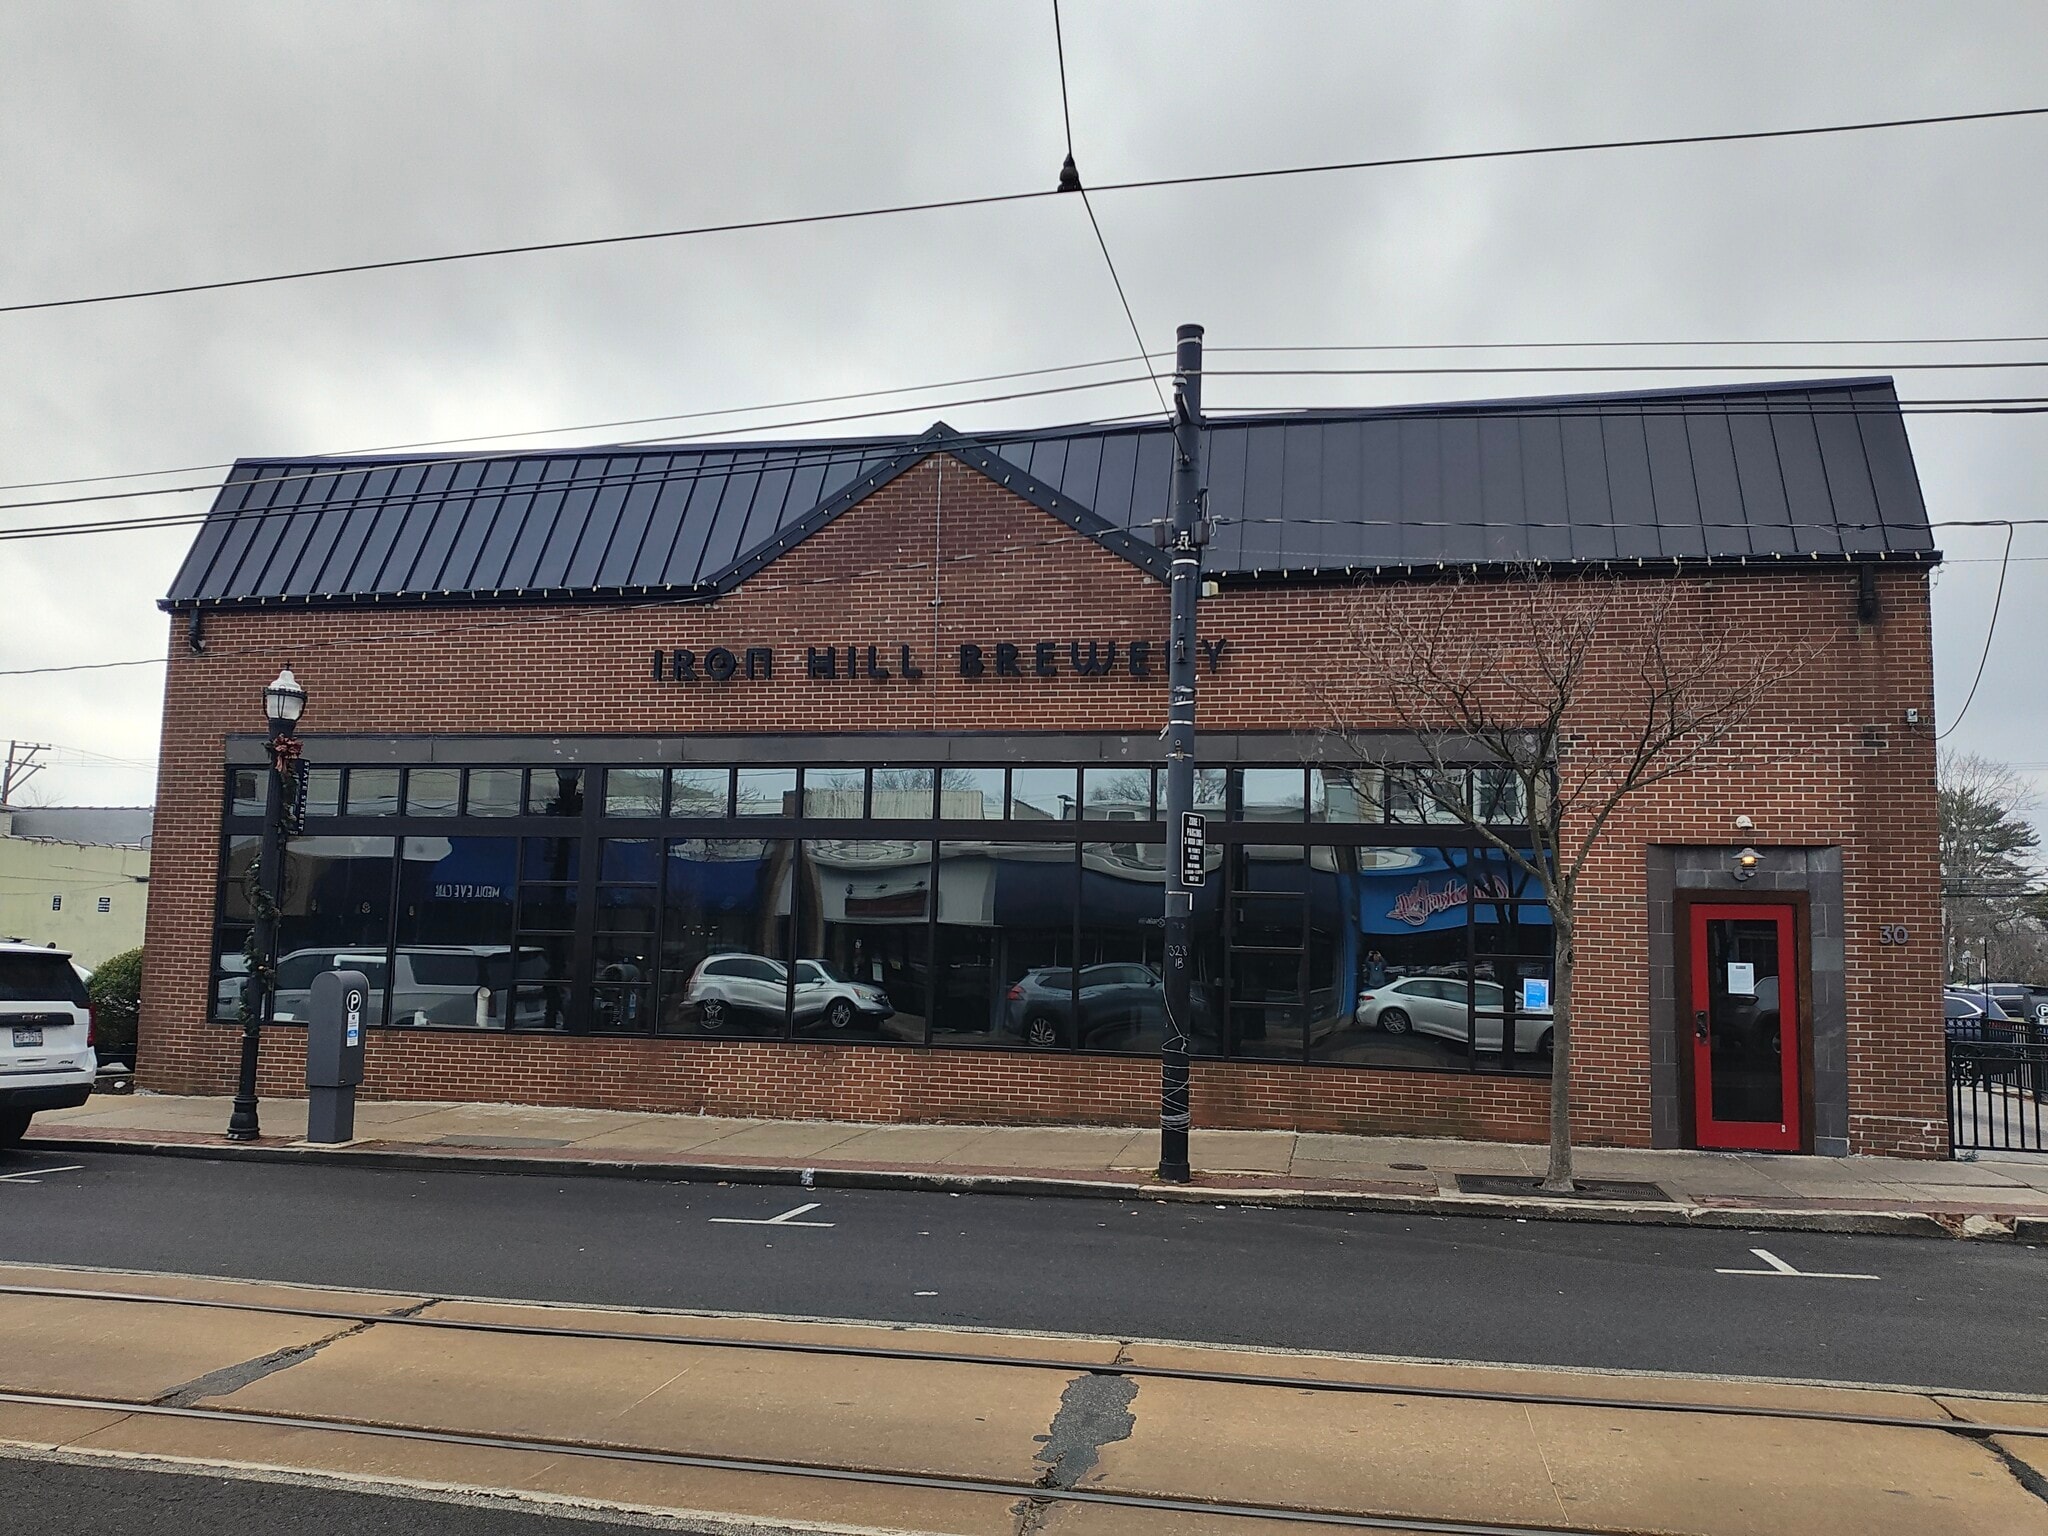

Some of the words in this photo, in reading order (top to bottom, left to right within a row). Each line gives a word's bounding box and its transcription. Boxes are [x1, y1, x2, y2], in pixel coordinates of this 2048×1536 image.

[653, 646, 773, 682] IRON
[808, 644, 923, 680] HILL
[959, 638, 1227, 678] BREWEY
[302, 761, 310, 791] STATE
[298, 795, 307, 831] STREET
[1879, 925, 1909, 945] 30
[1168, 945, 1188, 957] 328
[350, 994, 359, 1010] P
